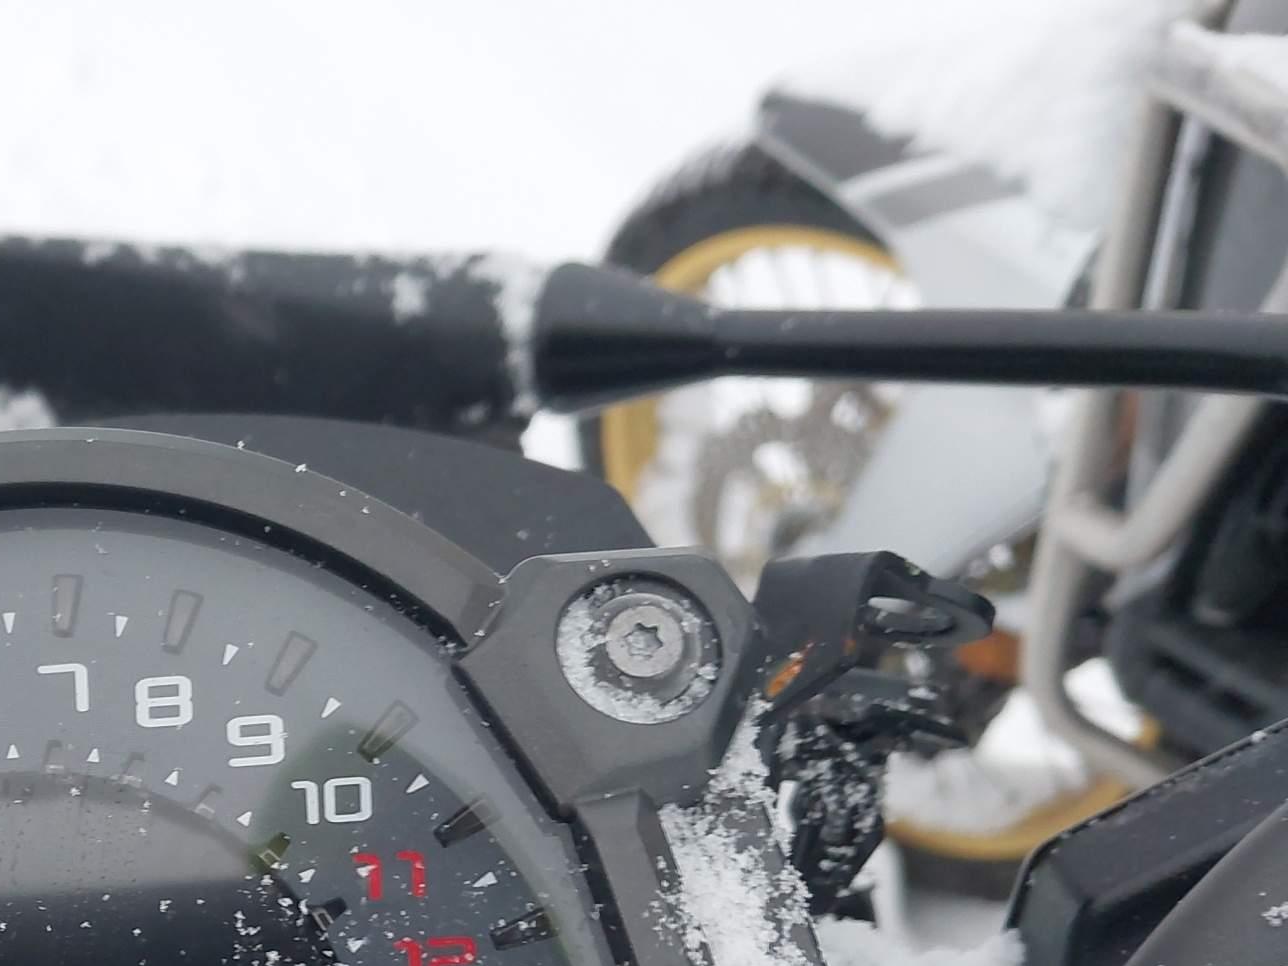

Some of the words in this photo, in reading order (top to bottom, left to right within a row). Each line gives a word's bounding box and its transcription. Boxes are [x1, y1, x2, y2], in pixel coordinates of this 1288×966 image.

[37, 663, 90, 712] 7
[134, 675, 194, 727] 8
[226, 714, 286, 767] 9
[291, 776, 373, 825] 10
[353, 850, 426, 901] 11
